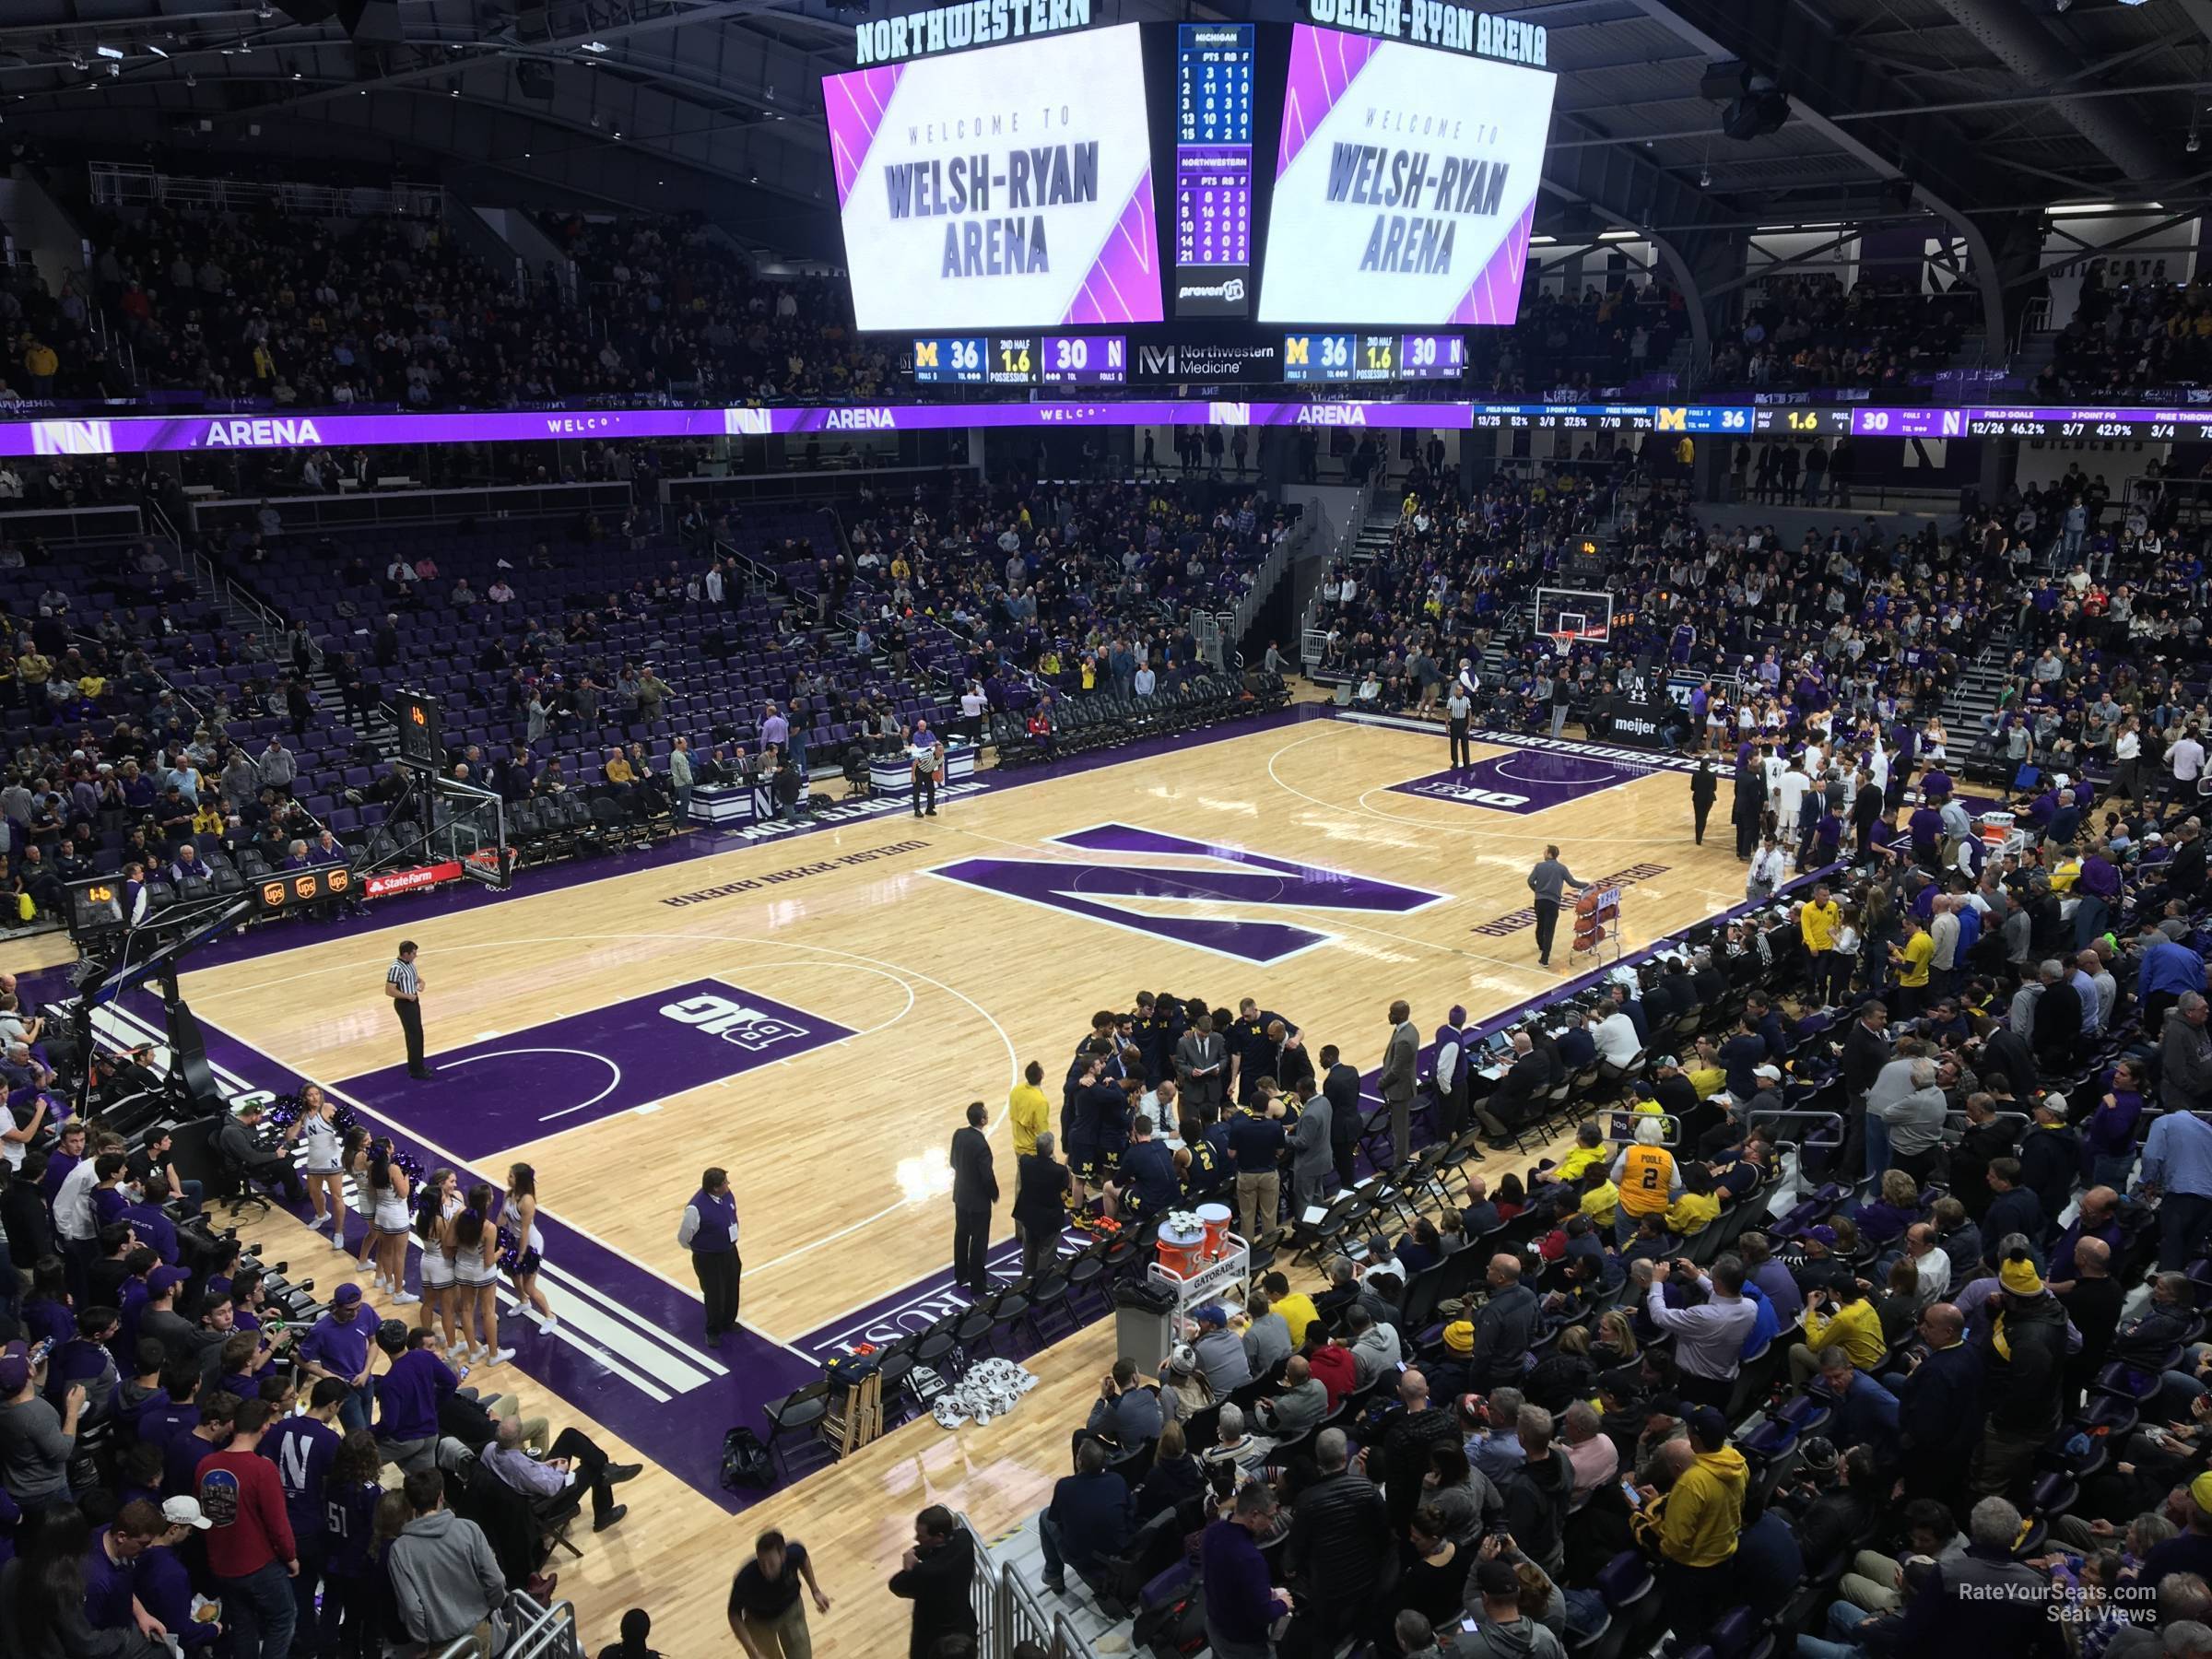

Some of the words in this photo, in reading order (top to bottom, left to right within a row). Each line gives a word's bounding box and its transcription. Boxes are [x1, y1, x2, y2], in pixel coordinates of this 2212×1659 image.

[856, 0, 1090, 65] NORTHWESTERN
[1194, 33, 1237, 42] MICHIGAN
[1311, 0, 1475, 51] WELSH-RYAN
[1477, 14, 1547, 65] ARENA
[1203, 53, 1219, 62] PTS
[1182, 66, 1189, 79] 1
[1206, 66, 1214, 79] 3
[1226, 66, 1232, 79] 1
[1241, 66, 1248, 79] 1
[1182, 82, 1191, 94] 2
[1203, 82, 1217, 94] 11
[1225, 82, 1232, 94] 1
[1241, 82, 1249, 94] 0
[1182, 97, 1190, 110] 3
[1206, 97, 1214, 110] 8
[1225, 97, 1232, 110] 3
[1241, 97, 1247, 110] 1
[1182, 112, 1195, 124] 13
[1203, 112, 1217, 124] 10
[1225, 112, 1231, 124] 1
[1241, 112, 1248, 124] 0
[908, 112, 1019, 147] WELCOME
[1043, 104, 1070, 128] TO
[1366, 106, 1463, 140] WELCOME
[1477, 124, 1500, 145] TO
[1182, 128, 1195, 140] 15
[1205, 128, 1214, 140] 4
[1224, 128, 1232, 140] 2
[1240, 128, 1247, 140] 1
[1182, 158, 1247, 167] NORTHWESTERN
[884, 141, 1100, 220] WELSH-RYAN
[1325, 141, 1511, 217] WELSH-RYAN
[1181, 191, 1190, 203] 4
[1205, 191, 1213, 203] 8
[1223, 191, 1231, 203] 2
[1239, 191, 1246, 203] 3
[1182, 206, 1189, 218] 5
[1202, 206, 1215, 218] 16
[1222, 206, 1230, 218] 4
[1239, 206, 1246, 218] 0
[1181, 220, 1194, 232] 10
[1205, 220, 1212, 232] 2
[1222, 220, 1230, 232] 0
[1238, 220, 1245, 232] 0
[941, 215, 1050, 279] ARENA
[1181, 235, 1194, 247] 14
[1204, 235, 1212, 247] 4
[1222, 235, 1230, 247] 0
[1238, 235, 1245, 247] 2
[1359, 213, 1457, 276] ARENA
[1181, 250, 1194, 262] 21
[1204, 250, 1212, 262] 0
[1222, 250, 1230, 262] 2
[1238, 250, 1244, 262] 0
[1000, 340, 1014, 350] 2ND
[1014, 339, 1030, 350] HALF
[1379, 336, 1393, 347] HALF
[915, 341, 938, 367] M
[950, 340, 979, 370] 36
[1056, 339, 1088, 370] 30
[1108, 340, 1122, 367] N
[1181, 345, 1274, 359] Northwestern
[1287, 337, 1309, 364] M
[1321, 336, 1347, 366] 36
[1412, 337, 1436, 365] 30
[1450, 339, 1460, 363] N
[1367, 347, 1392, 369] 1.6
[1001, 349, 1030, 371] 1.6
[990, 371, 1029, 382] POSSESSION
[826, 408, 895, 429] ARENA
[1297, 406, 1367, 425] ARENA
[1477, 416, 1500, 426] 13/25
[1511, 417, 1528, 426] 52%
[1539, 417, 1555, 426] 3/8
[1564, 417, 1587, 427] 37.5%
[1658, 408, 1687, 429] M
[1722, 411, 1745, 428] 36
[1788, 412, 1818, 429] 1.6
[1863, 412, 1888, 430] 30
[2156, 412, 2177, 420] FREE
[1600, 418, 1620, 428] 7/10
[1633, 418, 1652, 428] 70%
[1943, 411, 1959, 435] N
[1972, 422, 2005, 434] 12/26
[2011, 423, 2044, 434] 46.2%
[2063, 423, 2084, 436] 3/7
[2096, 424, 2131, 436] 42.9%
[206, 419, 322, 446] ARENA
[2151, 425, 2174, 438] 3/4
[1635, 677, 1644, 689] N
[1615, 718, 1656, 735] meijer
[755, 786, 772, 818] N
[760, 840, 932, 885] WELSH-RYAN
[298, 882, 314, 896] ups
[330, 876, 347, 889] ups
[89, 887, 112, 901] 1.6
[267, 890, 283, 903] ups
[661, 879, 763, 907] ARENA
[1613, 1119, 1628, 1130] 109
[1201, 1152, 1213, 1171] 2
[1641, 1154, 1663, 1165] POOLE
[1642, 1168, 1658, 1190] 2
[1194, 1261, 1234, 1289] GATORADE
[279, 1430, 314, 1489] N
[328, 1500, 348, 1538] 51
